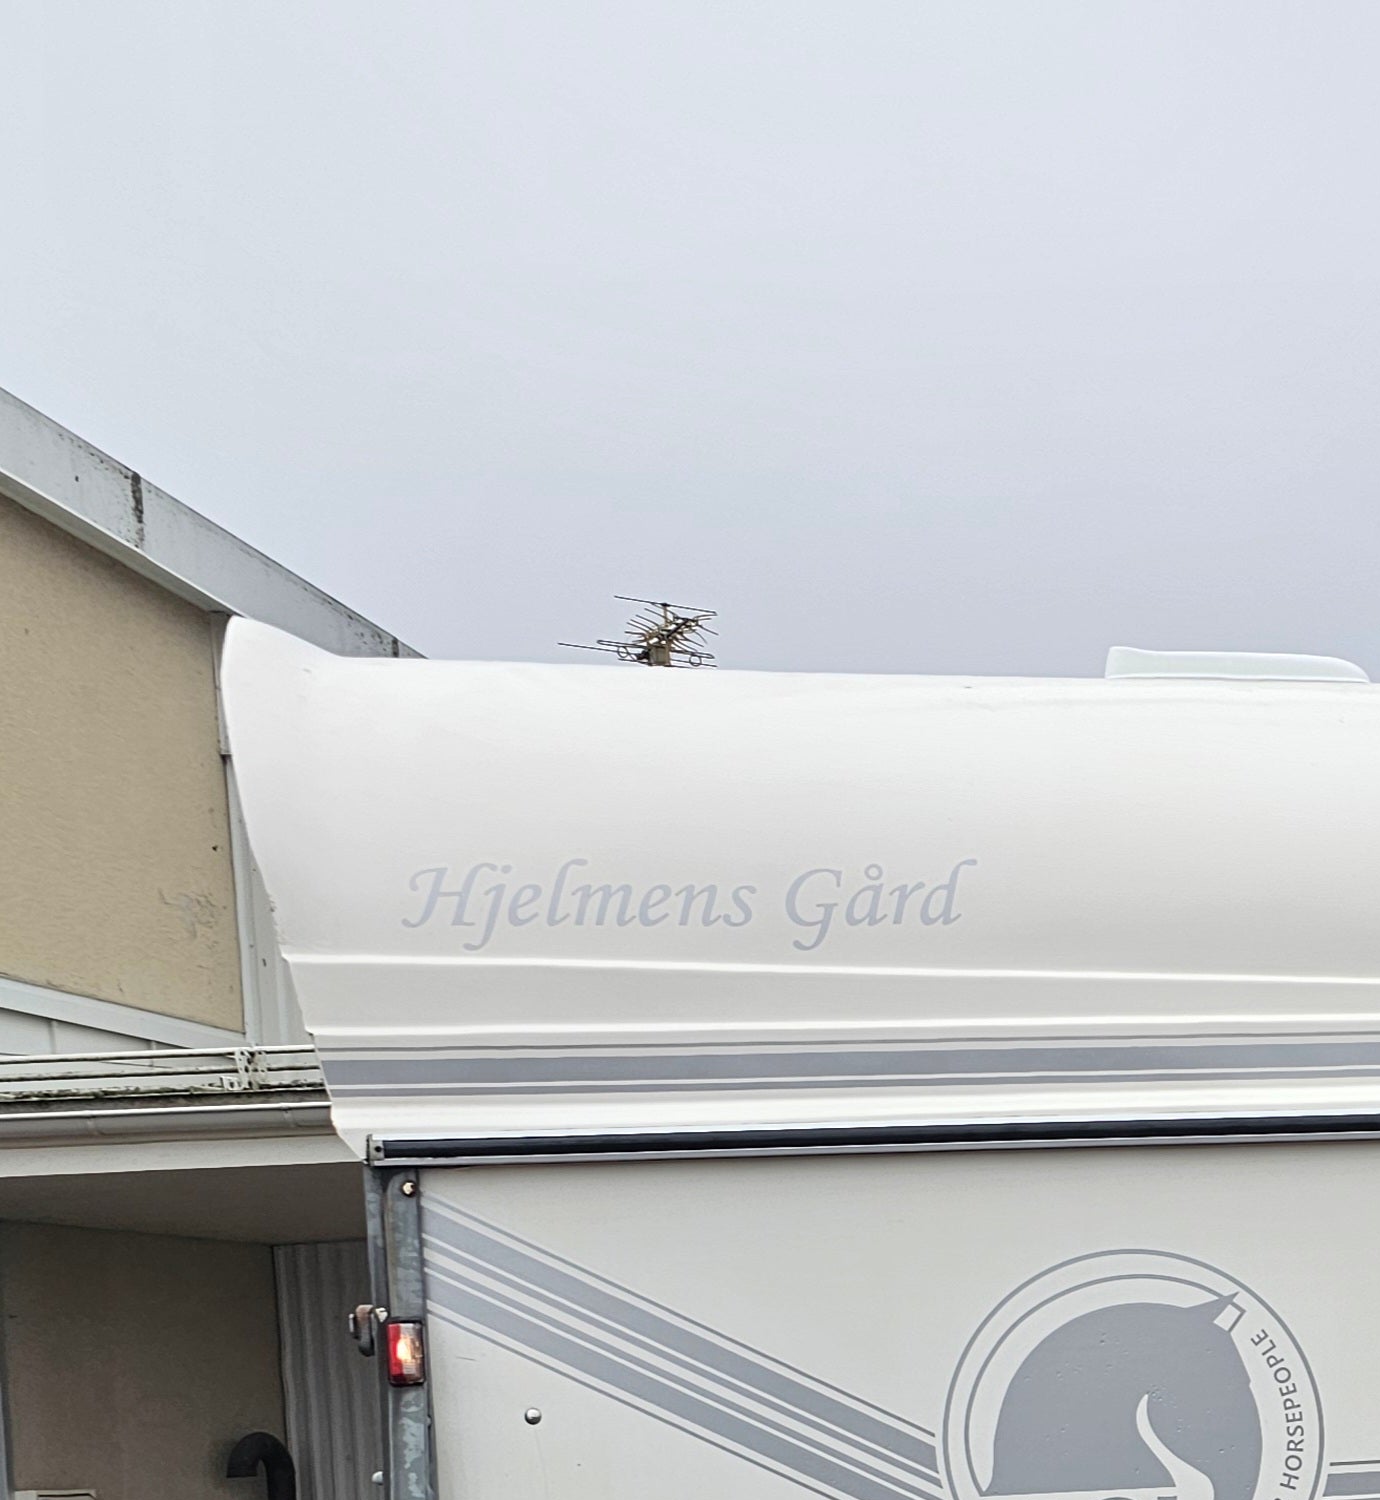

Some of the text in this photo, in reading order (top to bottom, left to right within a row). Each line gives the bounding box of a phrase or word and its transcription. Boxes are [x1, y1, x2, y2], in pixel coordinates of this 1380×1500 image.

[402, 857, 978, 951] Hjelmens Gård
[1250, 1329, 1304, 1491] HORSEPEOPLE
